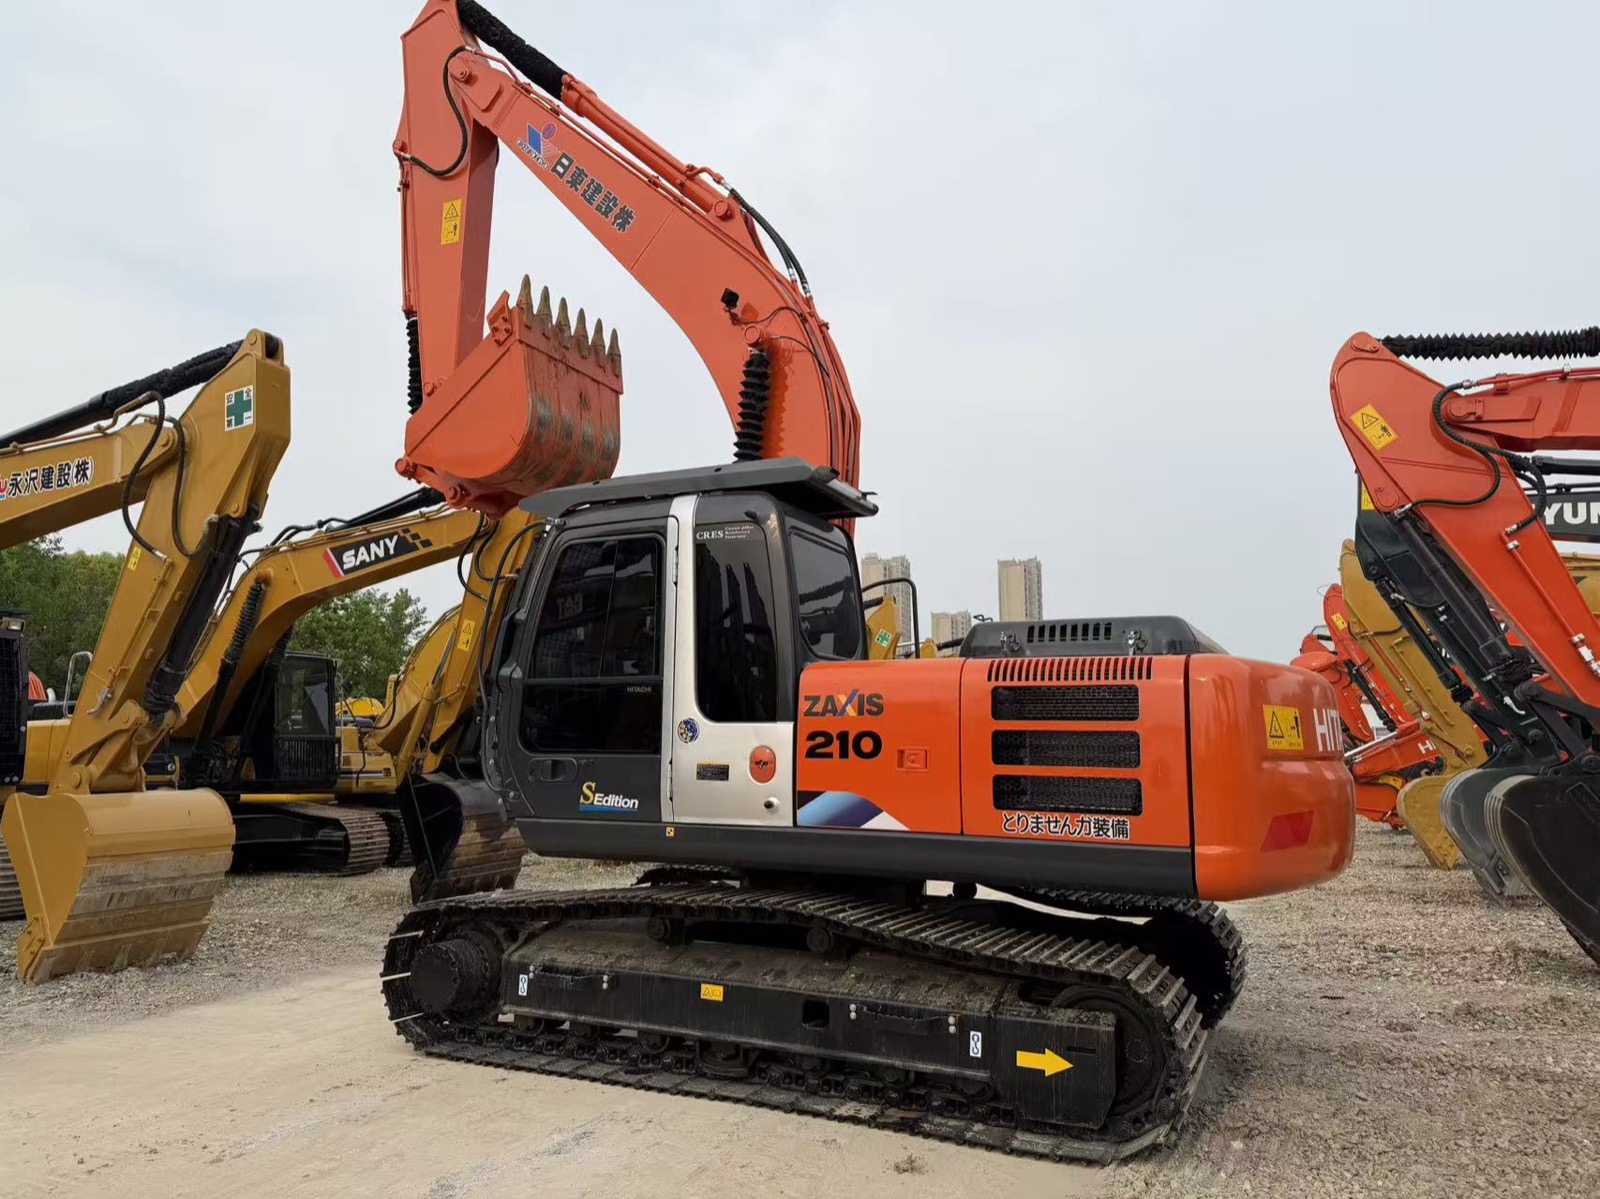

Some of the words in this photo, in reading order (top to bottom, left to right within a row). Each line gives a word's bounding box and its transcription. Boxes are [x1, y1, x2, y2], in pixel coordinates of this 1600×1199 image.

[9, 459, 92, 495] 永沢建設(株)
[696, 530, 724, 540] CRES
[342, 534, 399, 570] SANY
[803, 689, 885, 717] ZAXIS
[805, 730, 883, 760] 210
